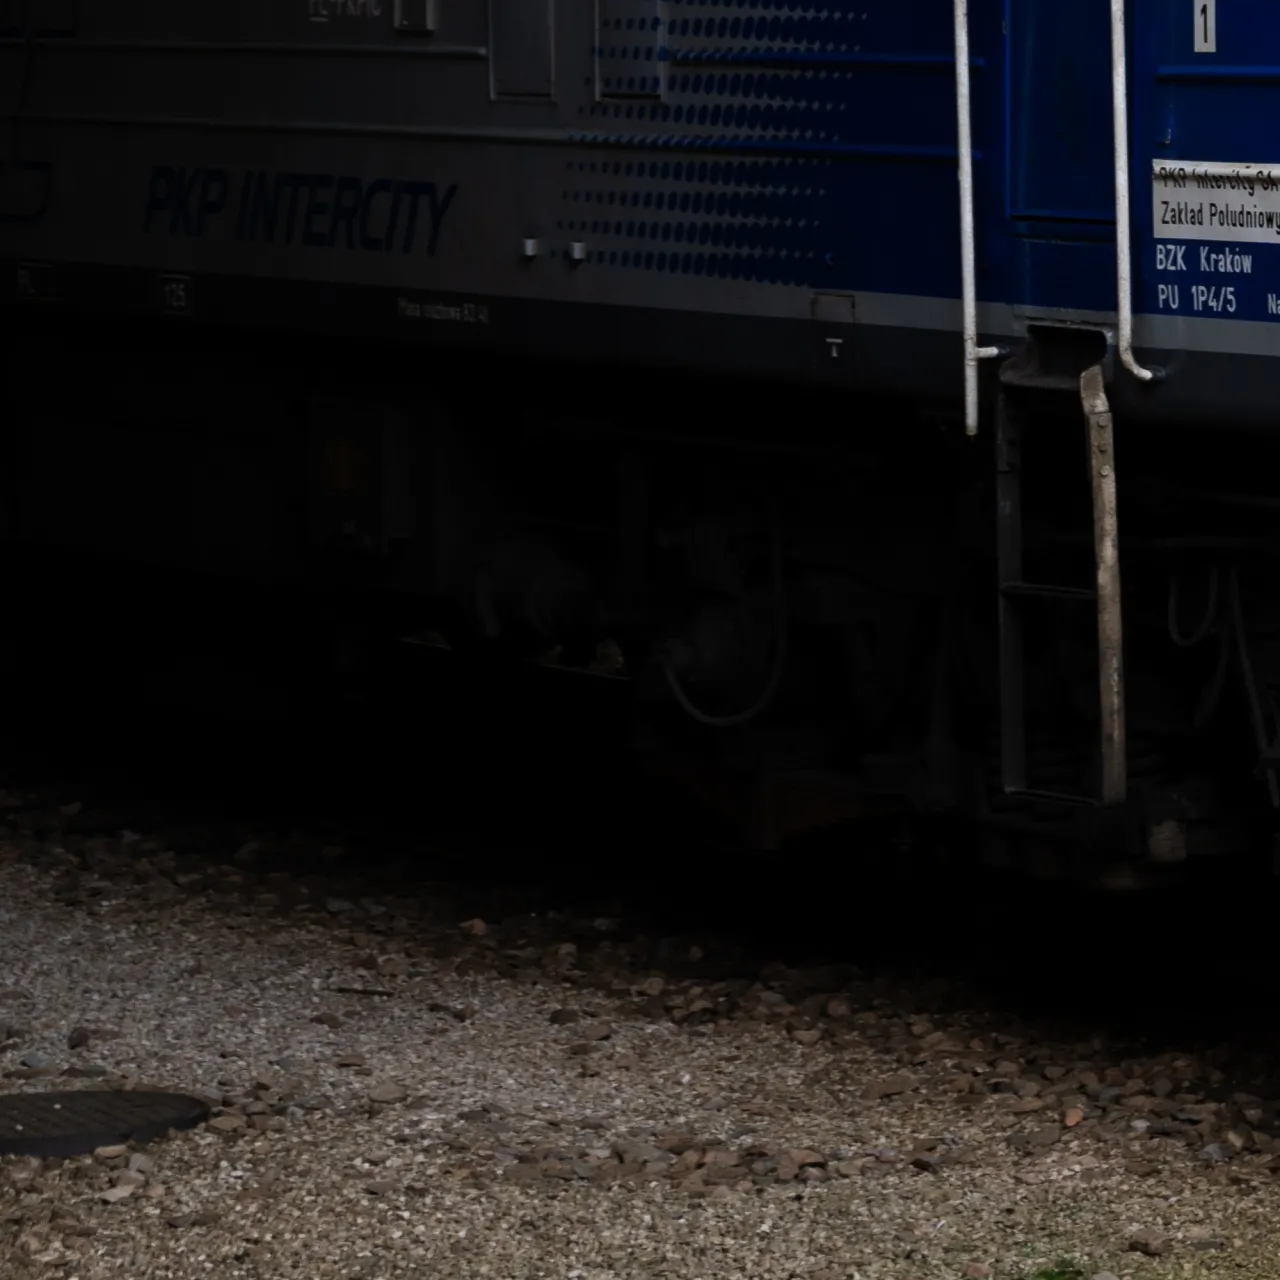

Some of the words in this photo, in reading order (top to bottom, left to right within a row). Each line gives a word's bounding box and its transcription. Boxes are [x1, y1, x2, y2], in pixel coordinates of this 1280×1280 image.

[1200, 4, 1208, 43] 1
[1159, 167, 1187, 188] PKP
[1256, 170, 1279, 191] SA
[142, 166, 228, 237] PKP
[235, 170, 458, 256] INTERCITY
[1156, 244, 1187, 271] BZK
[1200, 246, 1252, 273] Kraków
[1158, 284, 1179, 309] PU
[1191, 285, 1237, 313] 1P4/5
